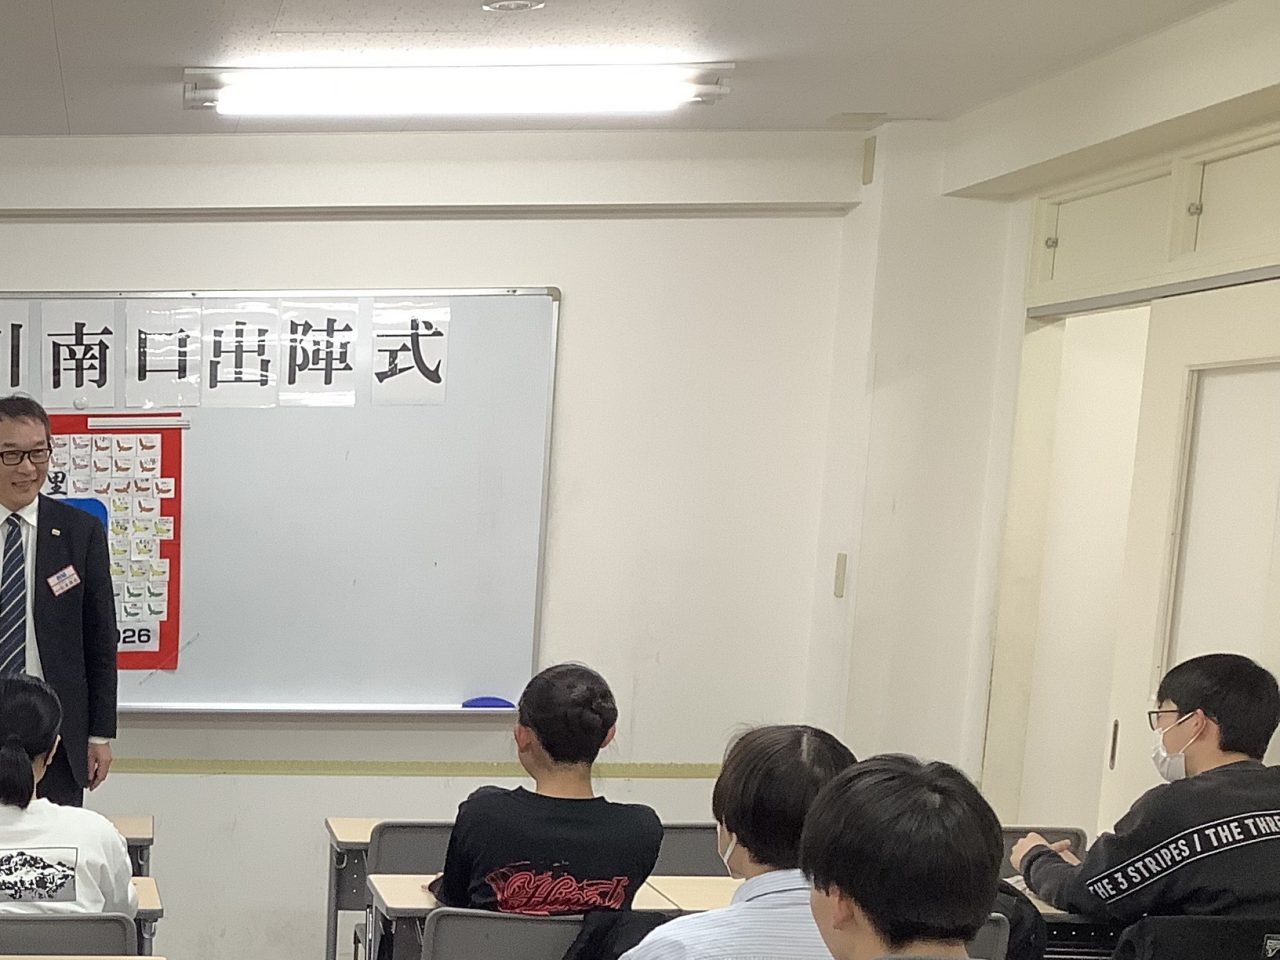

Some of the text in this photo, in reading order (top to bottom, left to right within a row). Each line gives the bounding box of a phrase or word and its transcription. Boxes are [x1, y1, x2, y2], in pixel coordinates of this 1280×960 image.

[116, 628, 152, 644] 26
[1114, 872, 1128, 889] 3
[1127, 838, 1190, 883] STRIPES
[1193, 833, 1202, 852] /
[1205, 821, 1245, 847] THE
